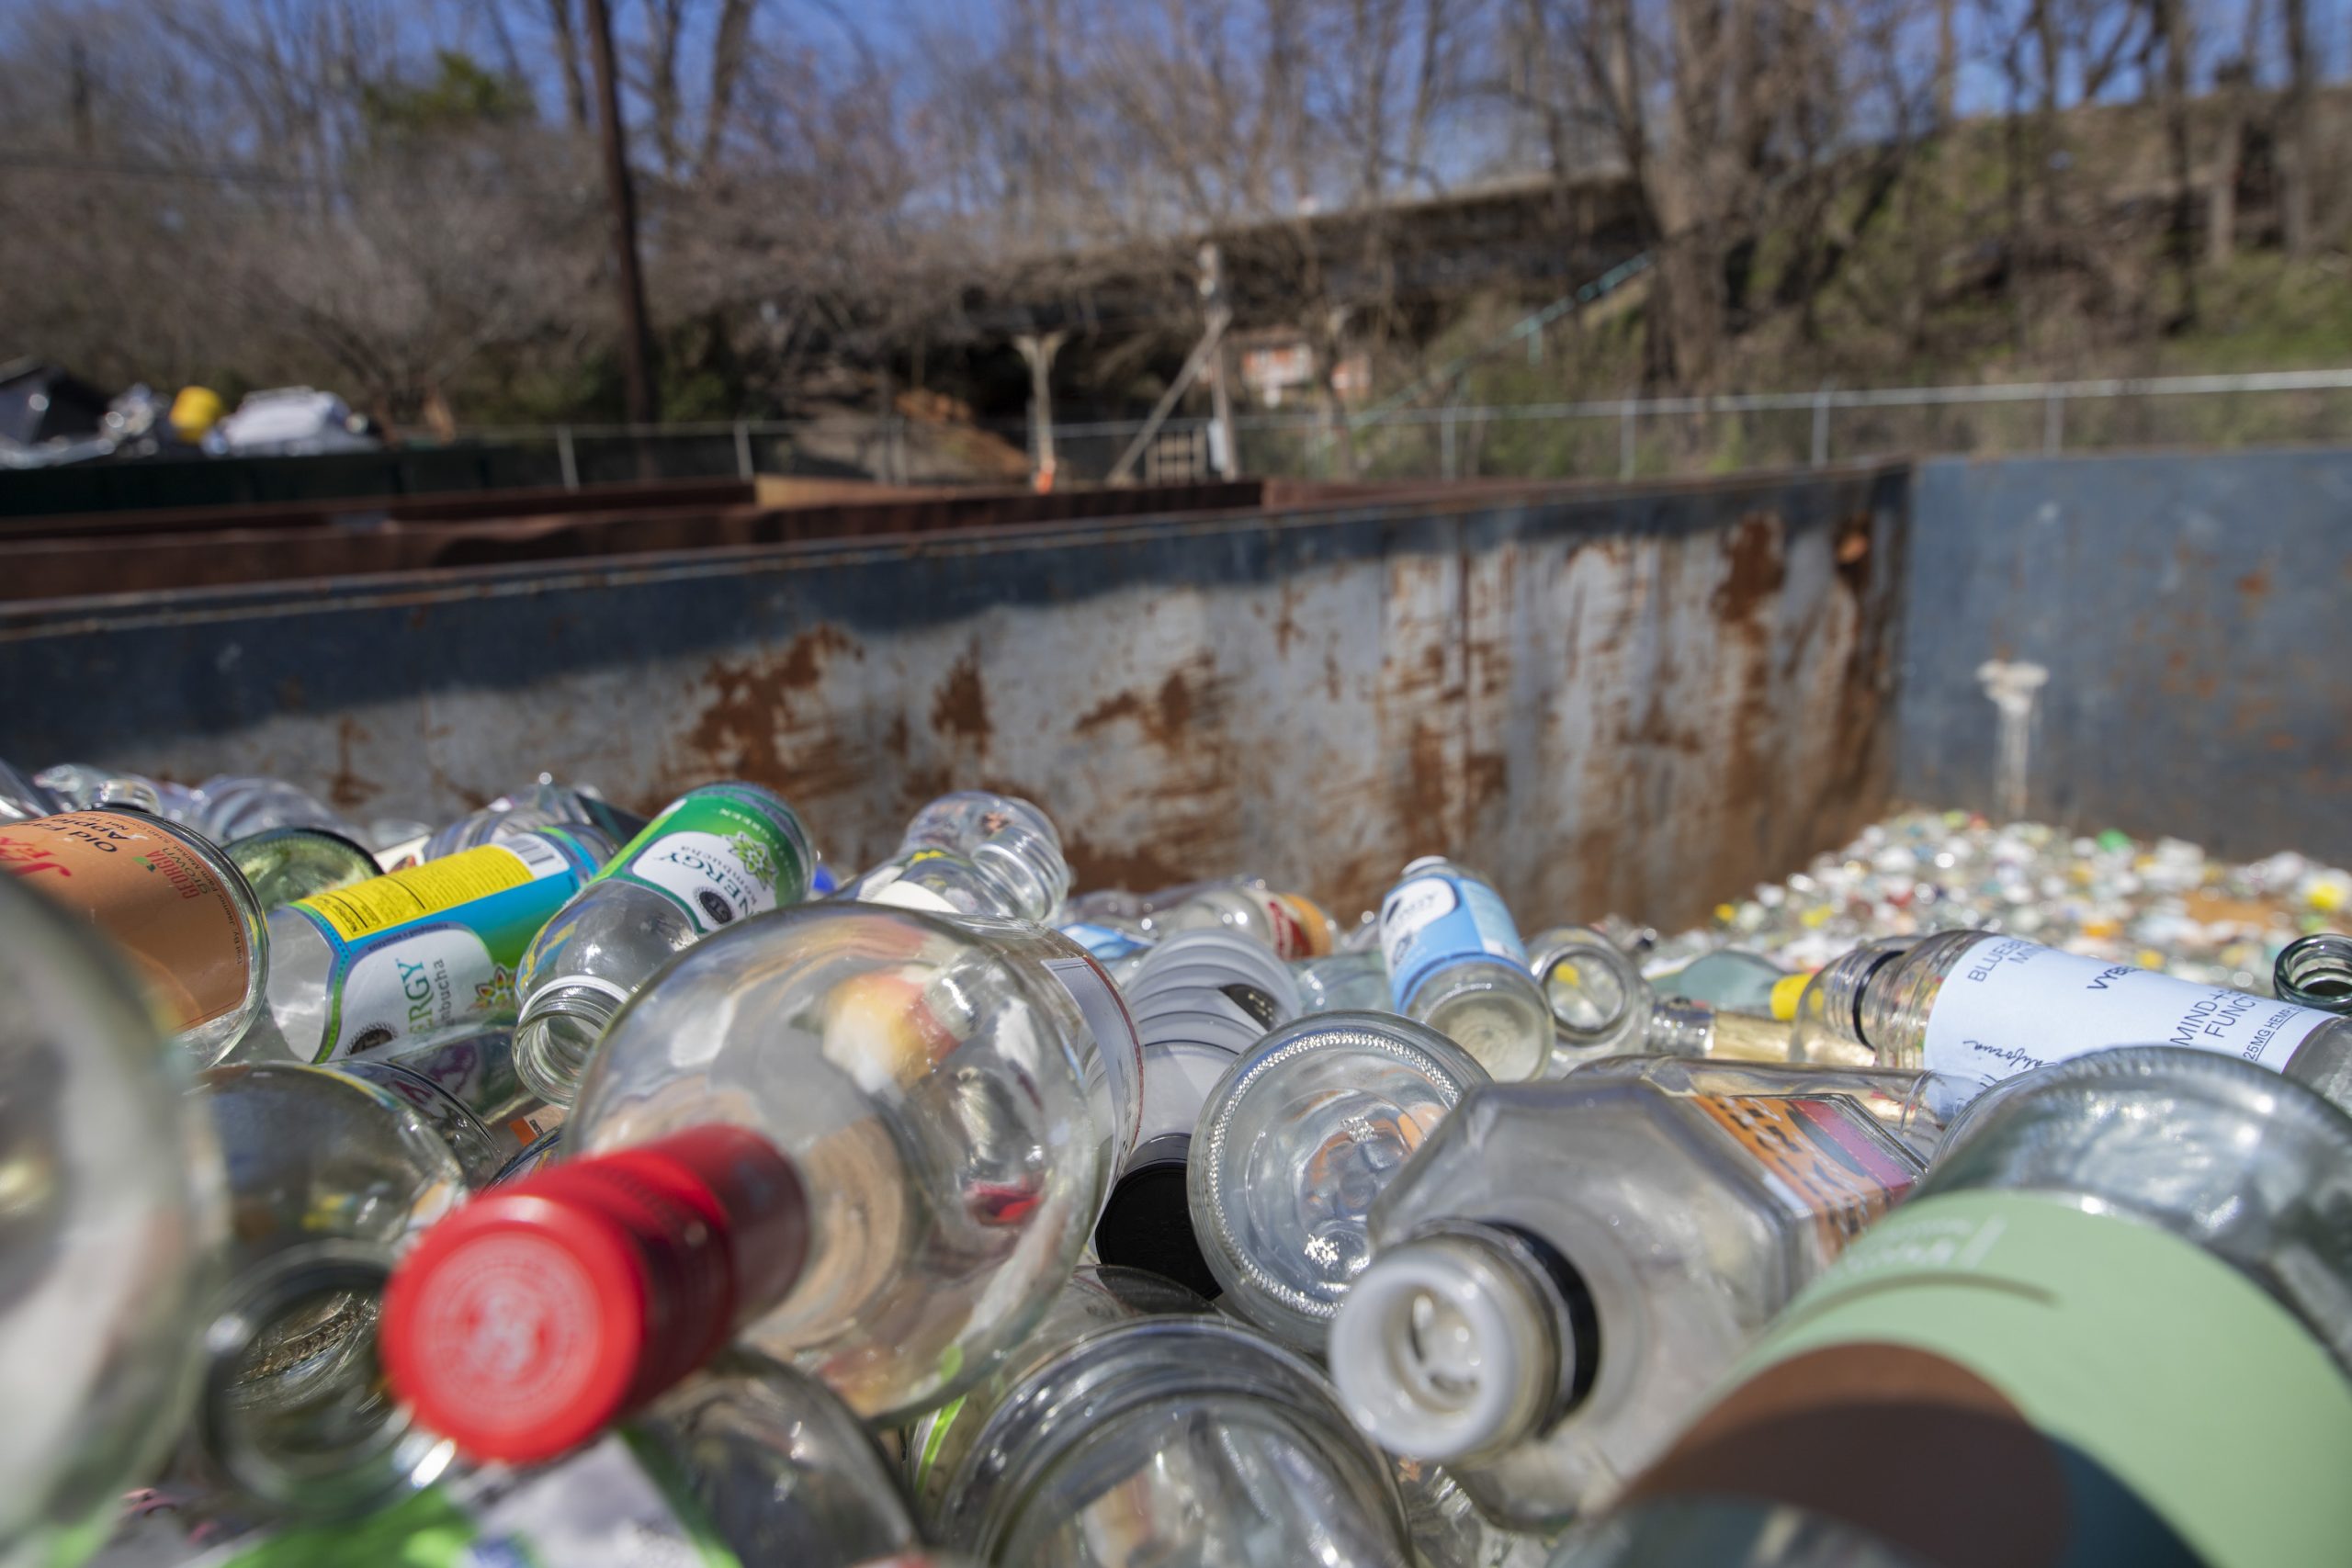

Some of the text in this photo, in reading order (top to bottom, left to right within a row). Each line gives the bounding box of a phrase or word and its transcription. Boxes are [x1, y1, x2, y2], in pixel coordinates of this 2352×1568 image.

[51, 818, 131, 840] Apple
[68, 830, 118, 852] Old
[105, 821, 130, 830] Net
[145, 850, 200, 899] GEORGIA
[163, 848, 209, 895] grown
[201, 869, 219, 894] Farm
[653, 852, 753, 919] NERGY
[1967, 940, 2027, 982] BLUEB
[396, 961, 435, 1034] ERGY
[433, 958, 457, 1027] mbucha
[2203, 994, 2266, 1038] FUNCT
[2243, 1008, 2294, 1061] 25MG HEMP
